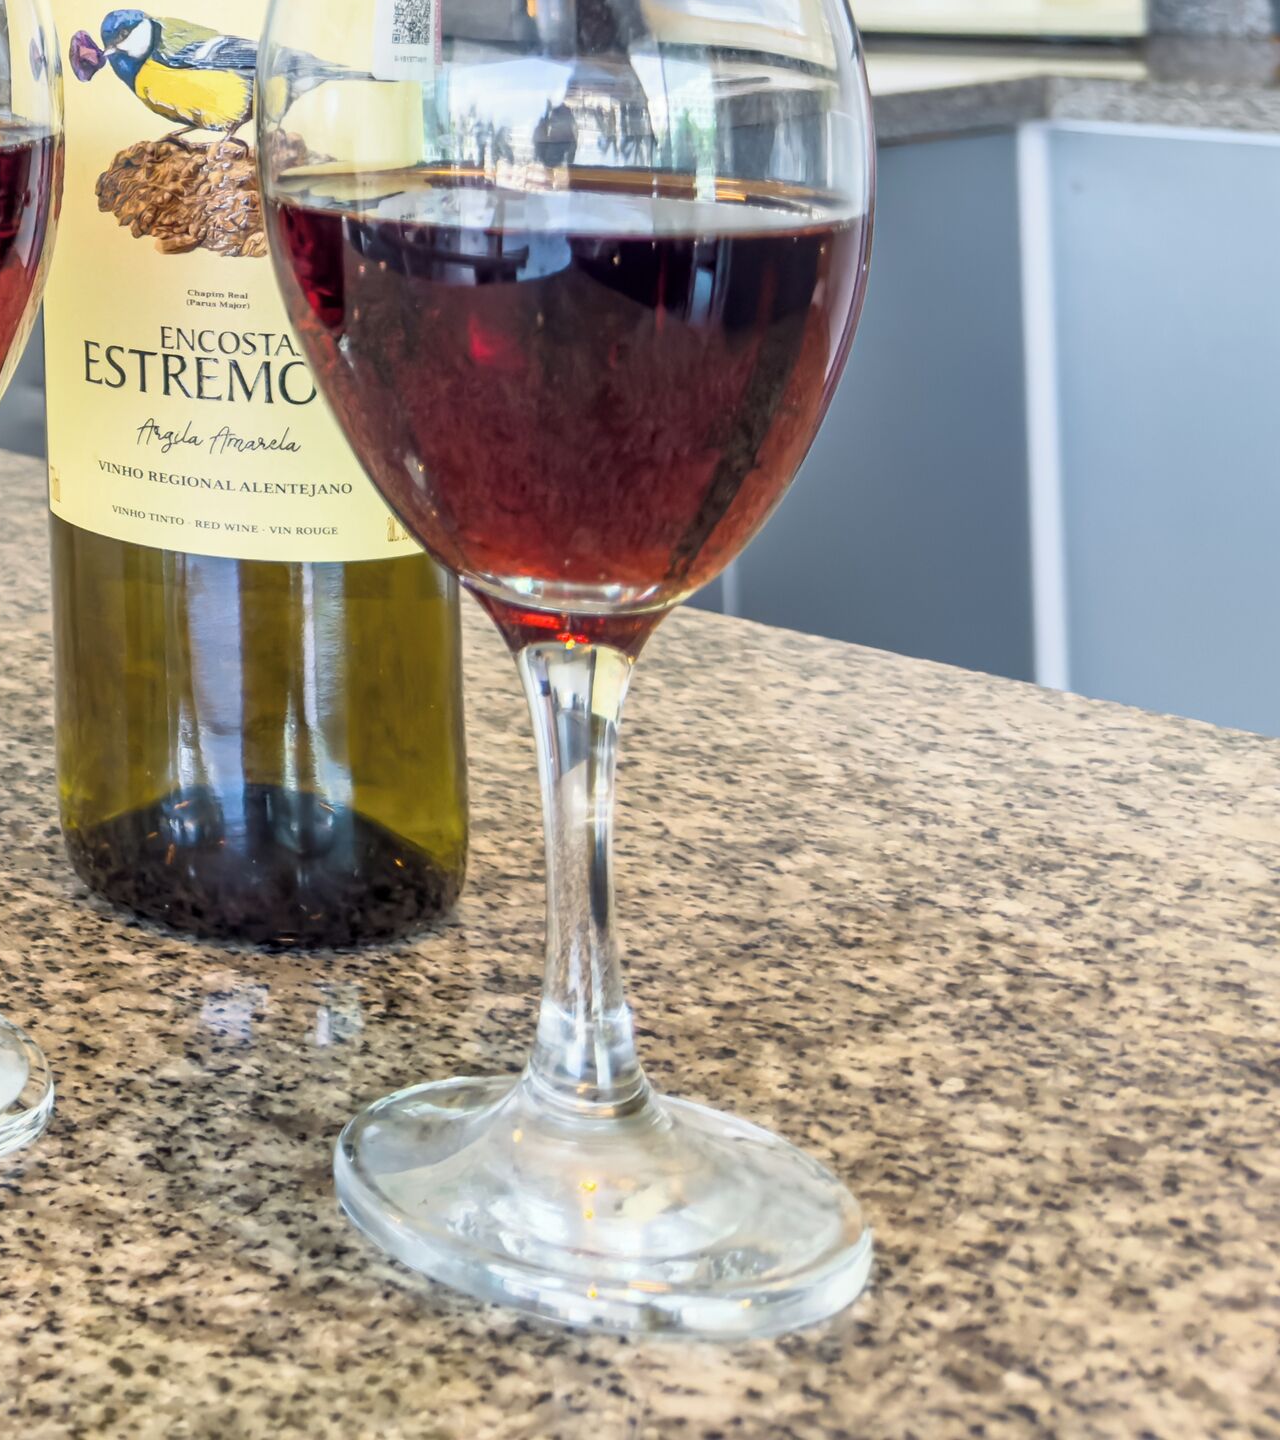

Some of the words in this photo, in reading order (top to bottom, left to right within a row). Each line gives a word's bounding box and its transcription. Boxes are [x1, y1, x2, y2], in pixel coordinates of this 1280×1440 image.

[186, 299, 216, 307] (Parus
[219, 301, 250, 309] Major)
[187, 289, 225, 298] Chapim
[160, 326, 302, 357] ENCOSTA
[84, 340, 317, 406] ESTREMO
[136, 417, 204, 454] Argila
[209, 426, 301, 455] Amarela
[98, 460, 144, 480] VINHO
[148, 470, 236, 492] REGIONAL
[240, 481, 353, 498] ALENTEJANO
[112, 504, 146, 520] VINHO
[149, 512, 185, 526] TINTO
[195, 519, 221, 531] RED
[224, 522, 259, 534] WINE
[269, 525, 291, 535] VIN
[296, 525, 339, 536] ROUGE
